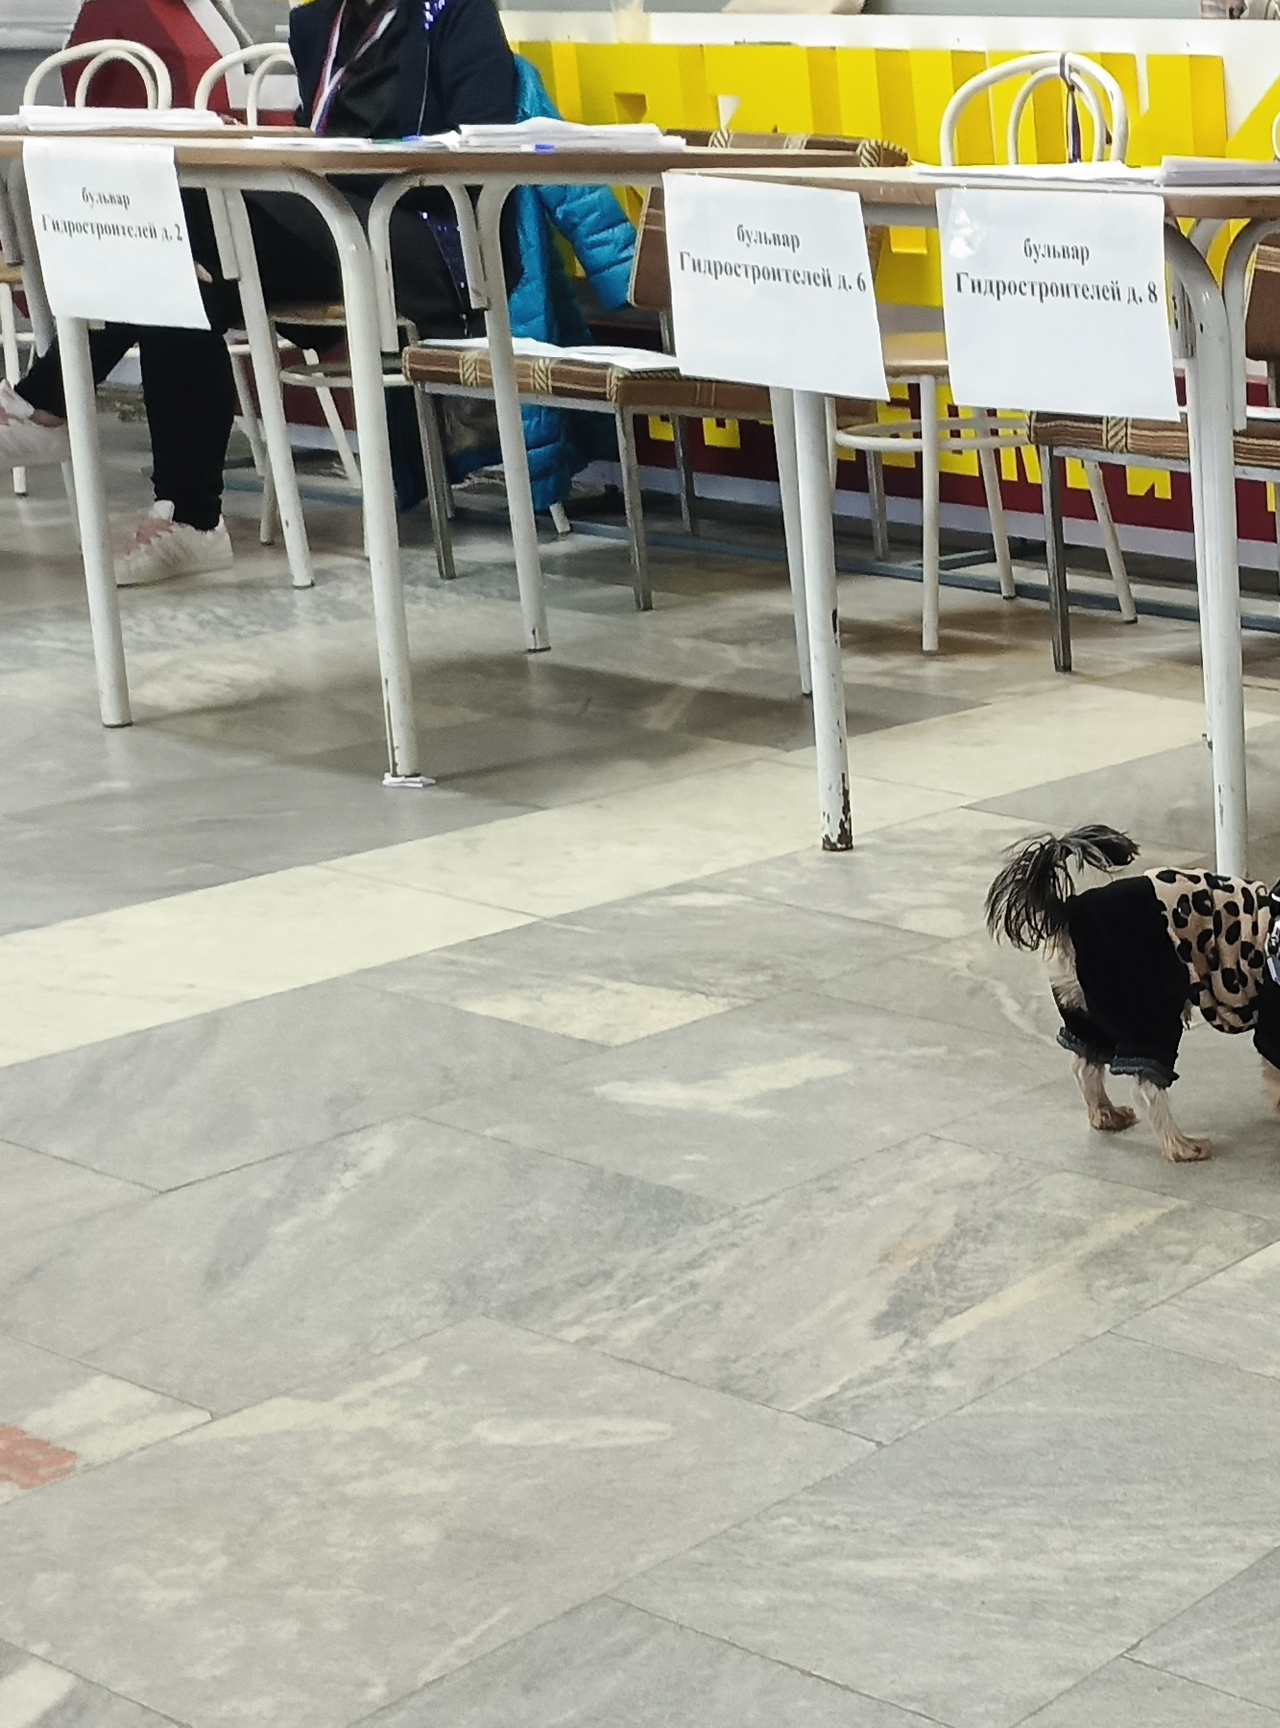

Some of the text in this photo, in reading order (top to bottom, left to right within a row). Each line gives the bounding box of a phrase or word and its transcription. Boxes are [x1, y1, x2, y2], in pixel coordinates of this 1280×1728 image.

[82, 187, 131, 211] бульвар
[41, 214, 184, 242] Гидростроителей д. 2
[736, 224, 800, 253] бульвар
[1023, 238, 1090, 265] бульвар
[679, 251, 867, 293] Гидростроителей д. 6
[956, 272, 1159, 305] Гидростроителей д. 8
